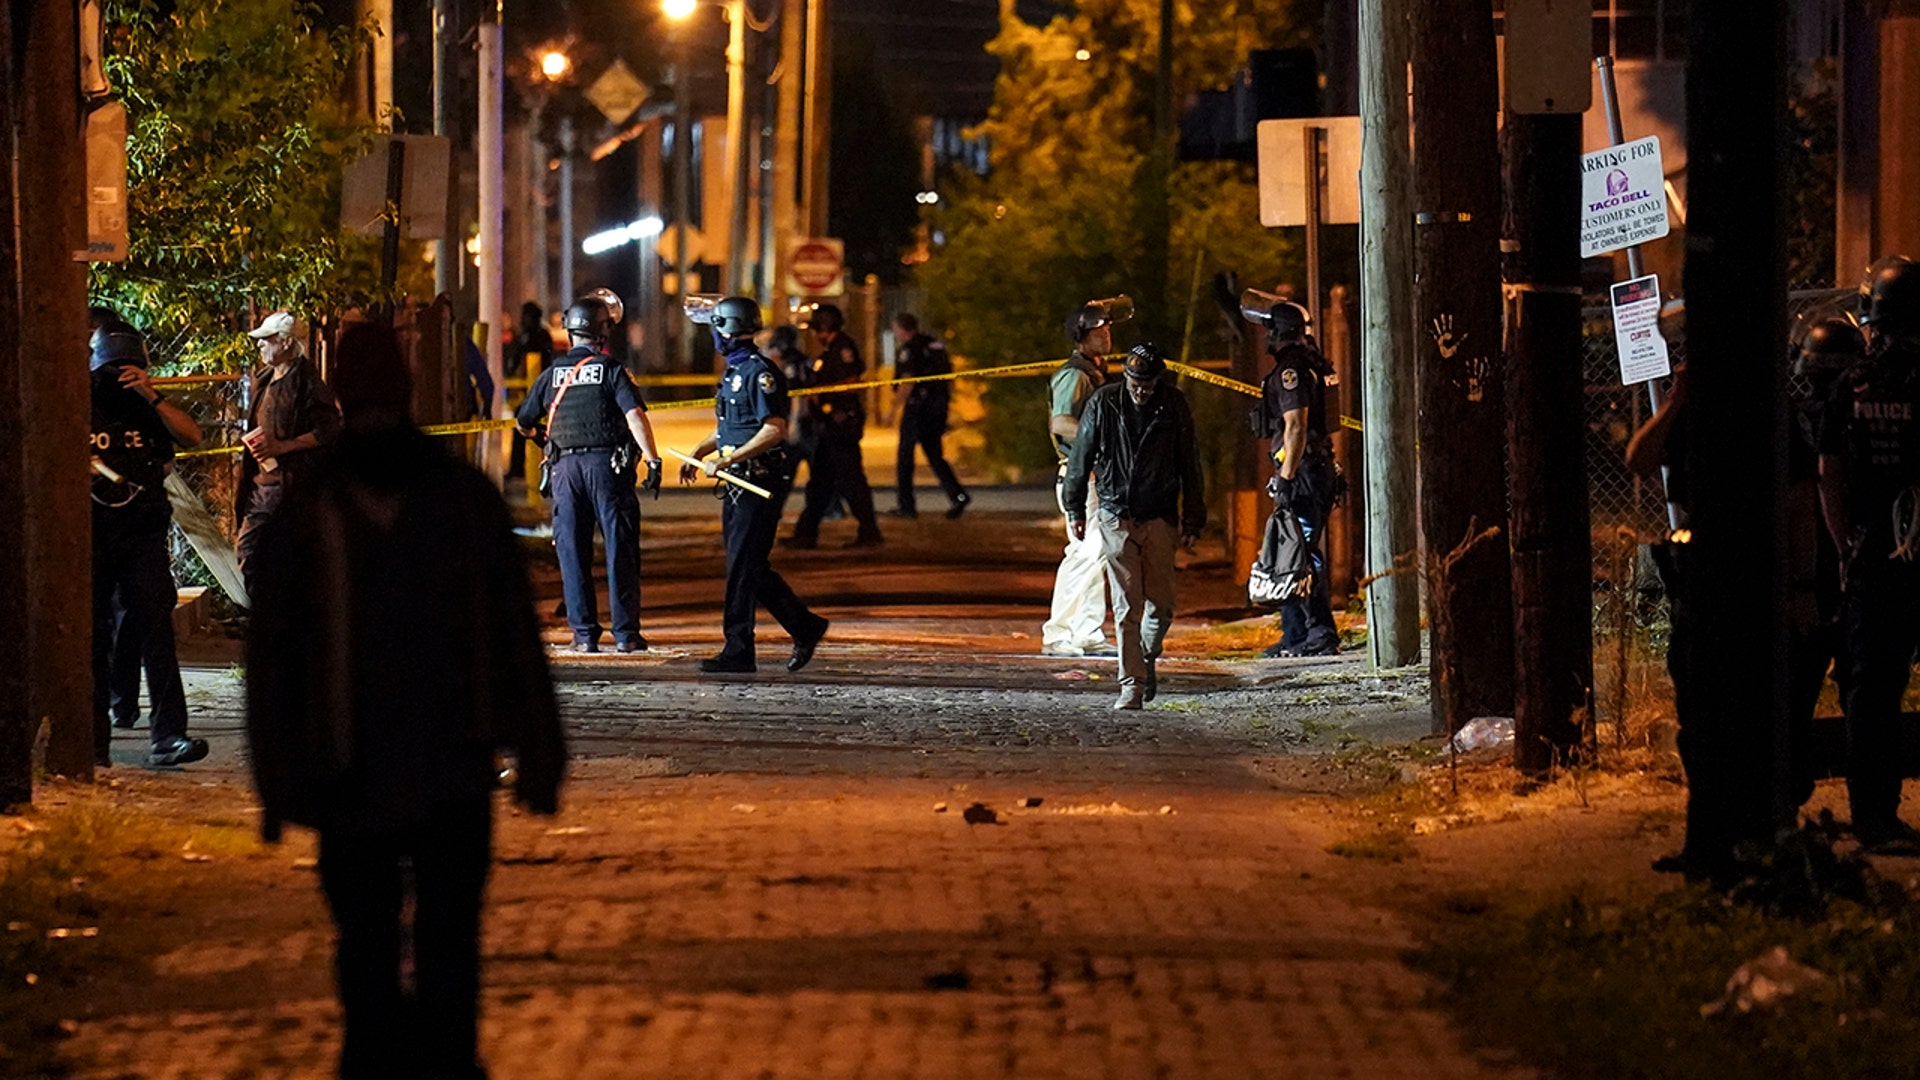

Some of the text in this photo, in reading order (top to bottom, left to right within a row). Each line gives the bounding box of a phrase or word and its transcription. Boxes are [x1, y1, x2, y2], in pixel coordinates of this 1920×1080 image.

[1631, 142, 1655, 160] FOR
[1588, 190, 1651, 212] TACO BELL
[1638, 200, 1661, 214] ONLY
[1643, 213, 1665, 225] TOWED
[1591, 241, 1599, 250] AT
[1630, 225, 1657, 240] EXPENSE
[557, 367, 599, 386] POLICE
[1853, 401, 1912, 420] POLICE
